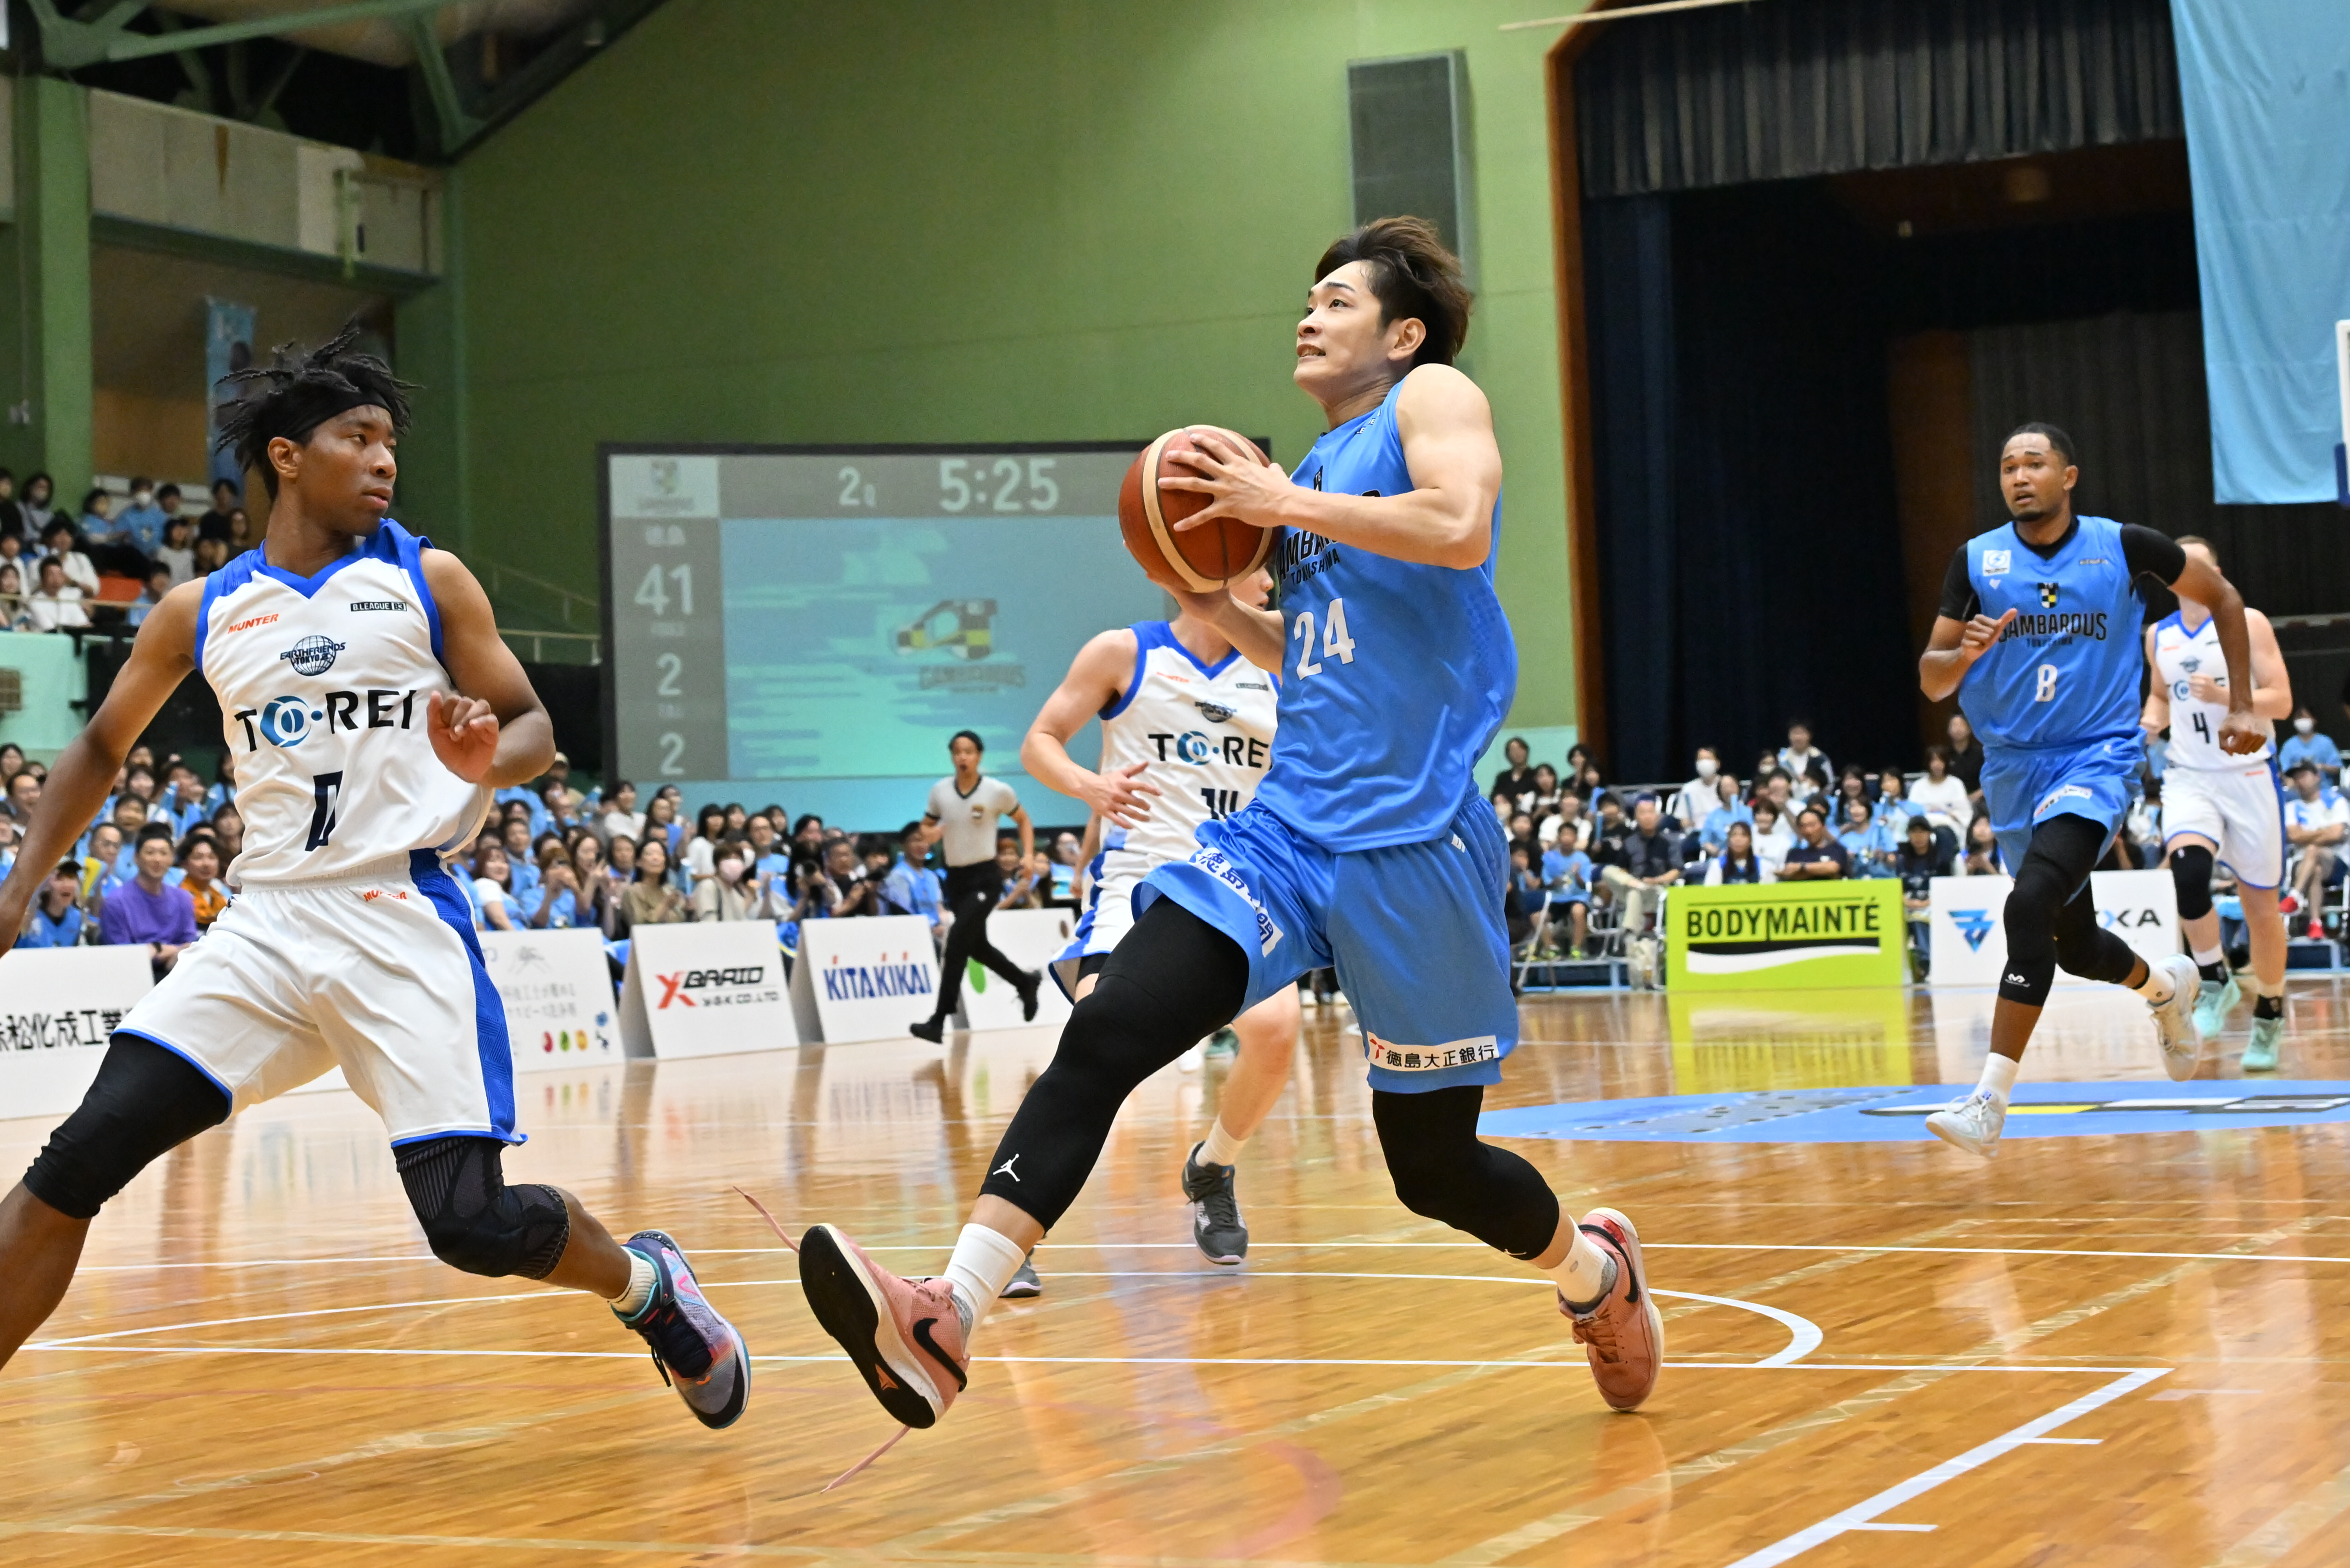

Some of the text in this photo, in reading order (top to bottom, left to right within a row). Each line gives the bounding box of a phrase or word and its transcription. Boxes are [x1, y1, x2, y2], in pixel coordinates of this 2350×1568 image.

[939, 458, 1060, 512] 5:25
[634, 563, 694, 616] 41
[228, 614, 279, 634] MUNTER
[1294, 598, 1355, 680] 24
[280, 642, 346, 660] EARTHFRIENDS
[295, 654, 319, 665] TOKYO
[657, 652, 681, 695] 2
[2035, 664, 2058, 702] 8
[2193, 712, 2210, 744] 4
[660, 732, 683, 775] 2
[1687, 896, 1880, 940] BODYMAINTÉ
[1386, 1044, 1495, 1068] 徳島大正銀行
